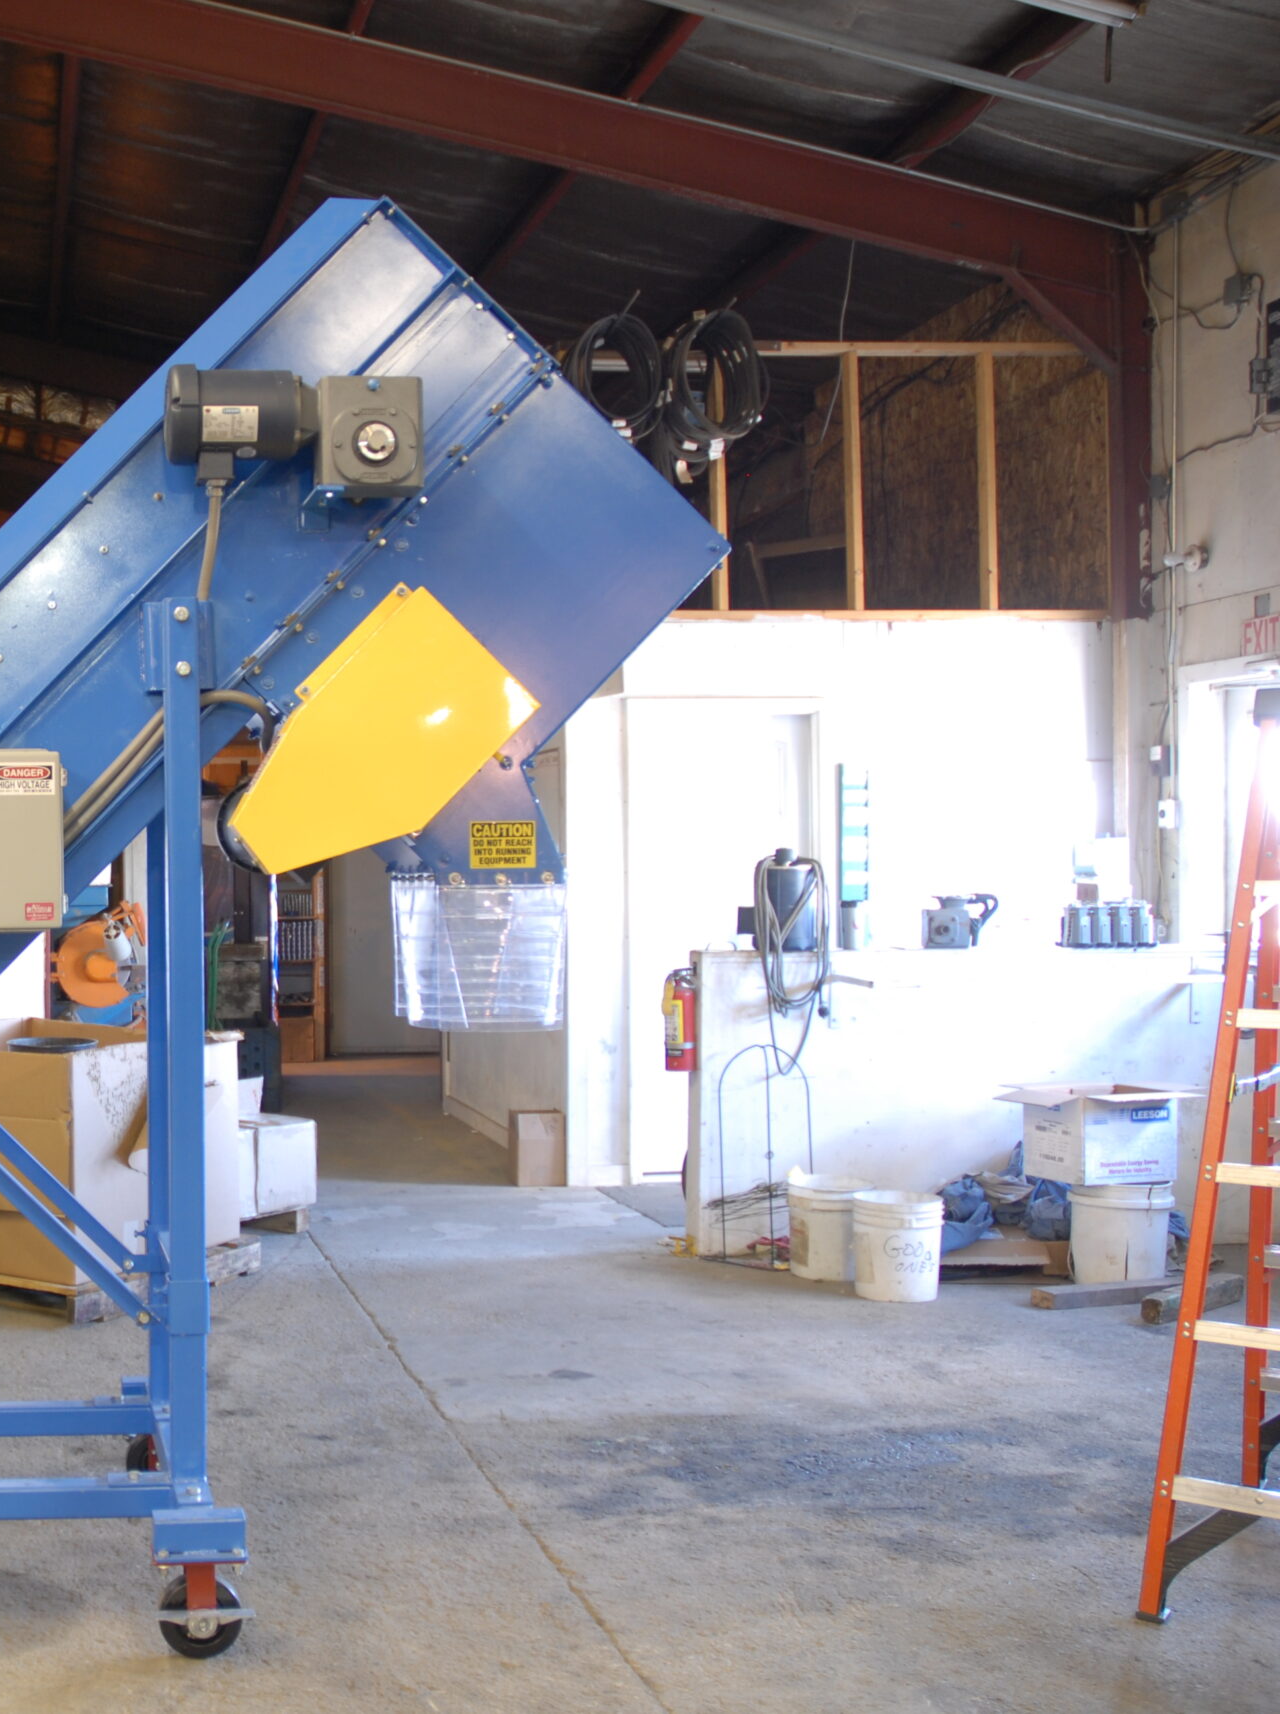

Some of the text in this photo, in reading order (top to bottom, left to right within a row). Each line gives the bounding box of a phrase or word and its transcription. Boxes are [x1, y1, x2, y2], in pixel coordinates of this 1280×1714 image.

[3, 768, 44, 777] DANGER
[17, 780, 50, 789] VOLTAGE
[472, 823, 532, 837] CAUTION
[473, 839, 484, 847] DO
[474, 848, 493, 856] INTO
[479, 857, 527, 865] EQUIPMENT
[1132, 1107, 1168, 1120] LEESON
